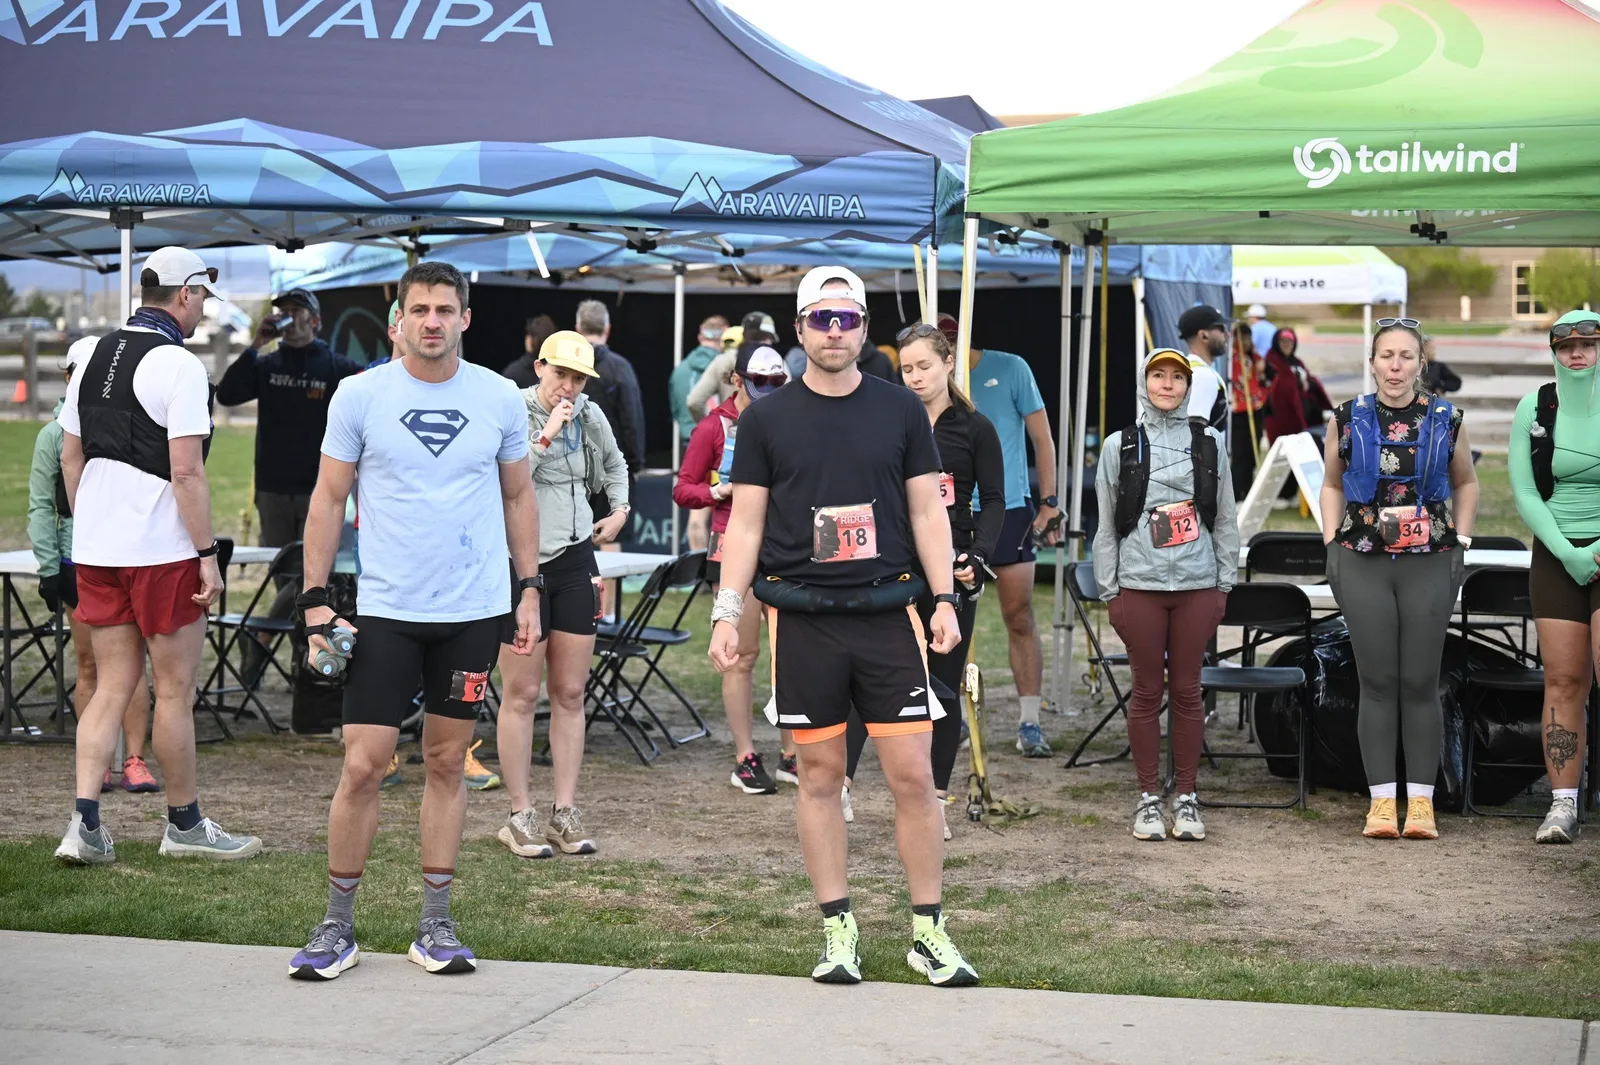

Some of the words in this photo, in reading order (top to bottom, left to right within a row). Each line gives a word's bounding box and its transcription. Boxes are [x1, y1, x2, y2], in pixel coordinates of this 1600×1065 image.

[32, 0, 554, 46] ARAVAIPA
[1355, 142, 1518, 173] tailwind
[77, 184, 212, 204] ARAVAIPA
[717, 192, 866, 219] ARAVAIPA
[1263, 278, 1325, 290] Elevate
[840, 515, 870, 525] RIDGE
[1174, 518, 1193, 534] 12
[842, 528, 868, 547] 18
[1402, 522, 1423, 537] 34
[473, 683, 483, 700] 9
